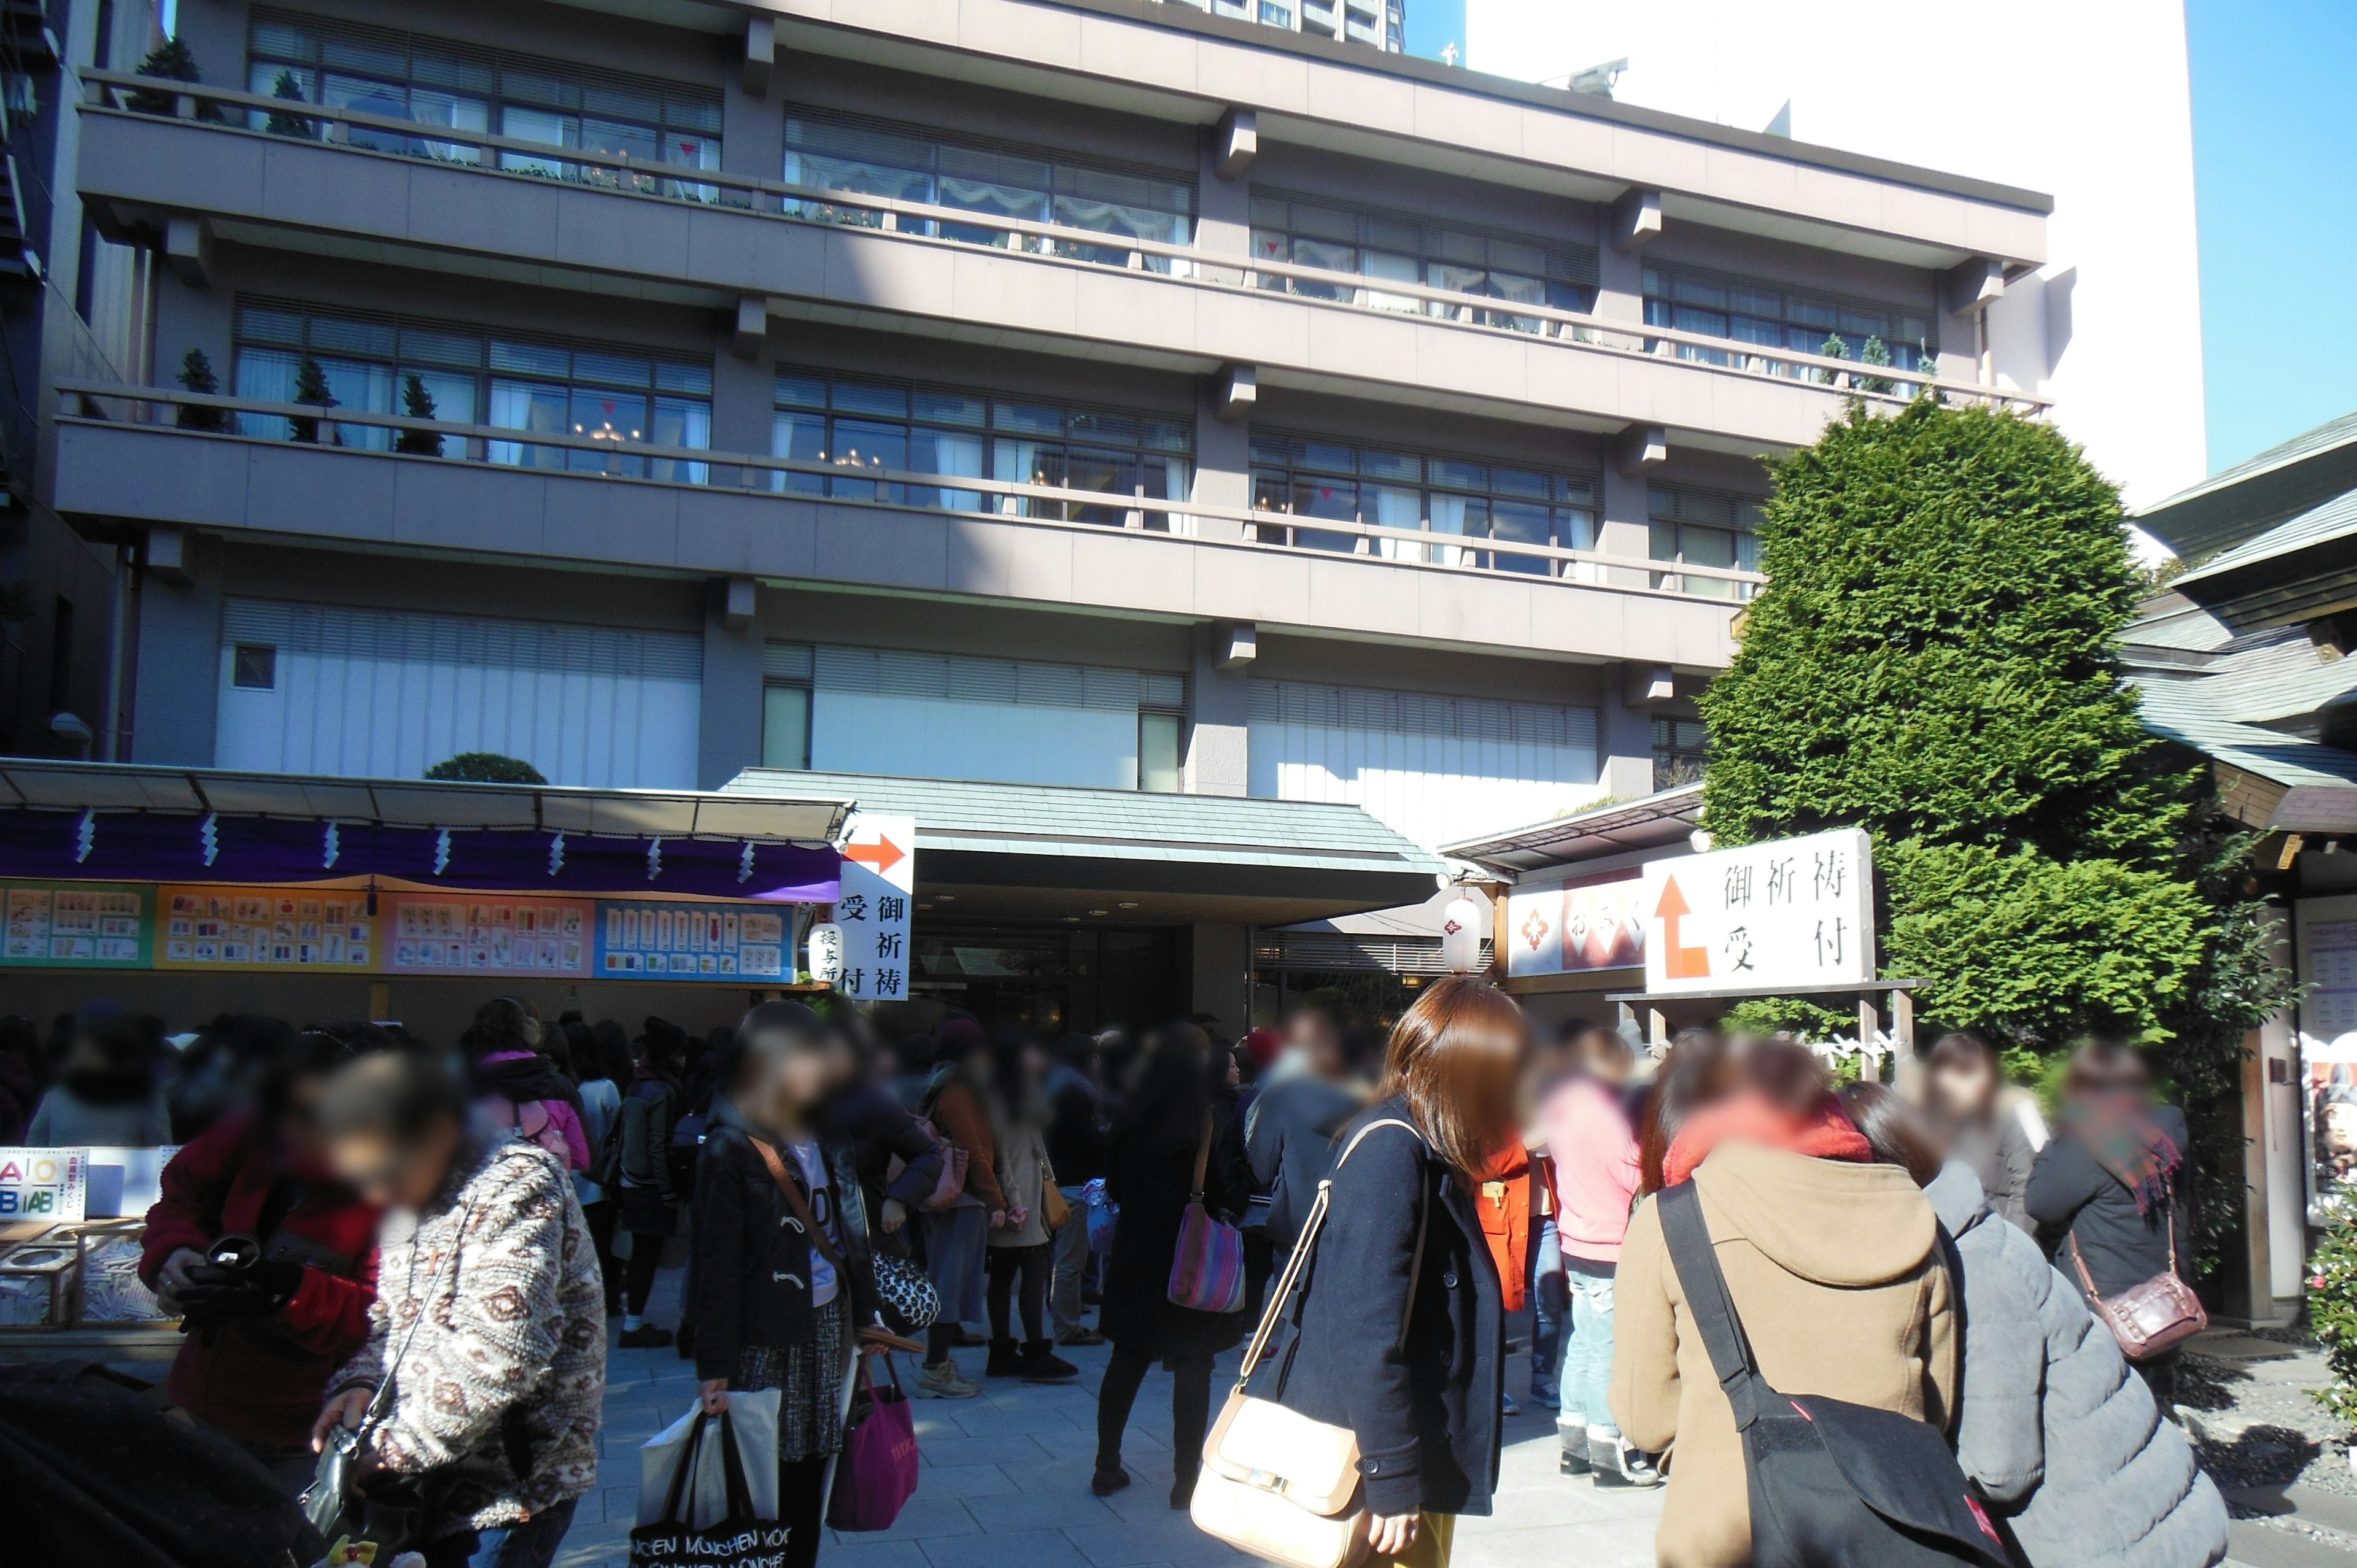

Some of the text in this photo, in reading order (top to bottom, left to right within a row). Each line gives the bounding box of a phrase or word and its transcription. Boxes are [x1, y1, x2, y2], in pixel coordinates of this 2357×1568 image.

[1725, 850, 1846, 910] 御祈祷
[819, 930, 838, 981] 授与所
[839, 894, 868, 994] 受付
[874, 895, 905, 995] 御祈祷
[1725, 917, 1848, 973] 受付
[0, 1159, 56, 1182] A O
[28, 1190, 54, 1213] AB
